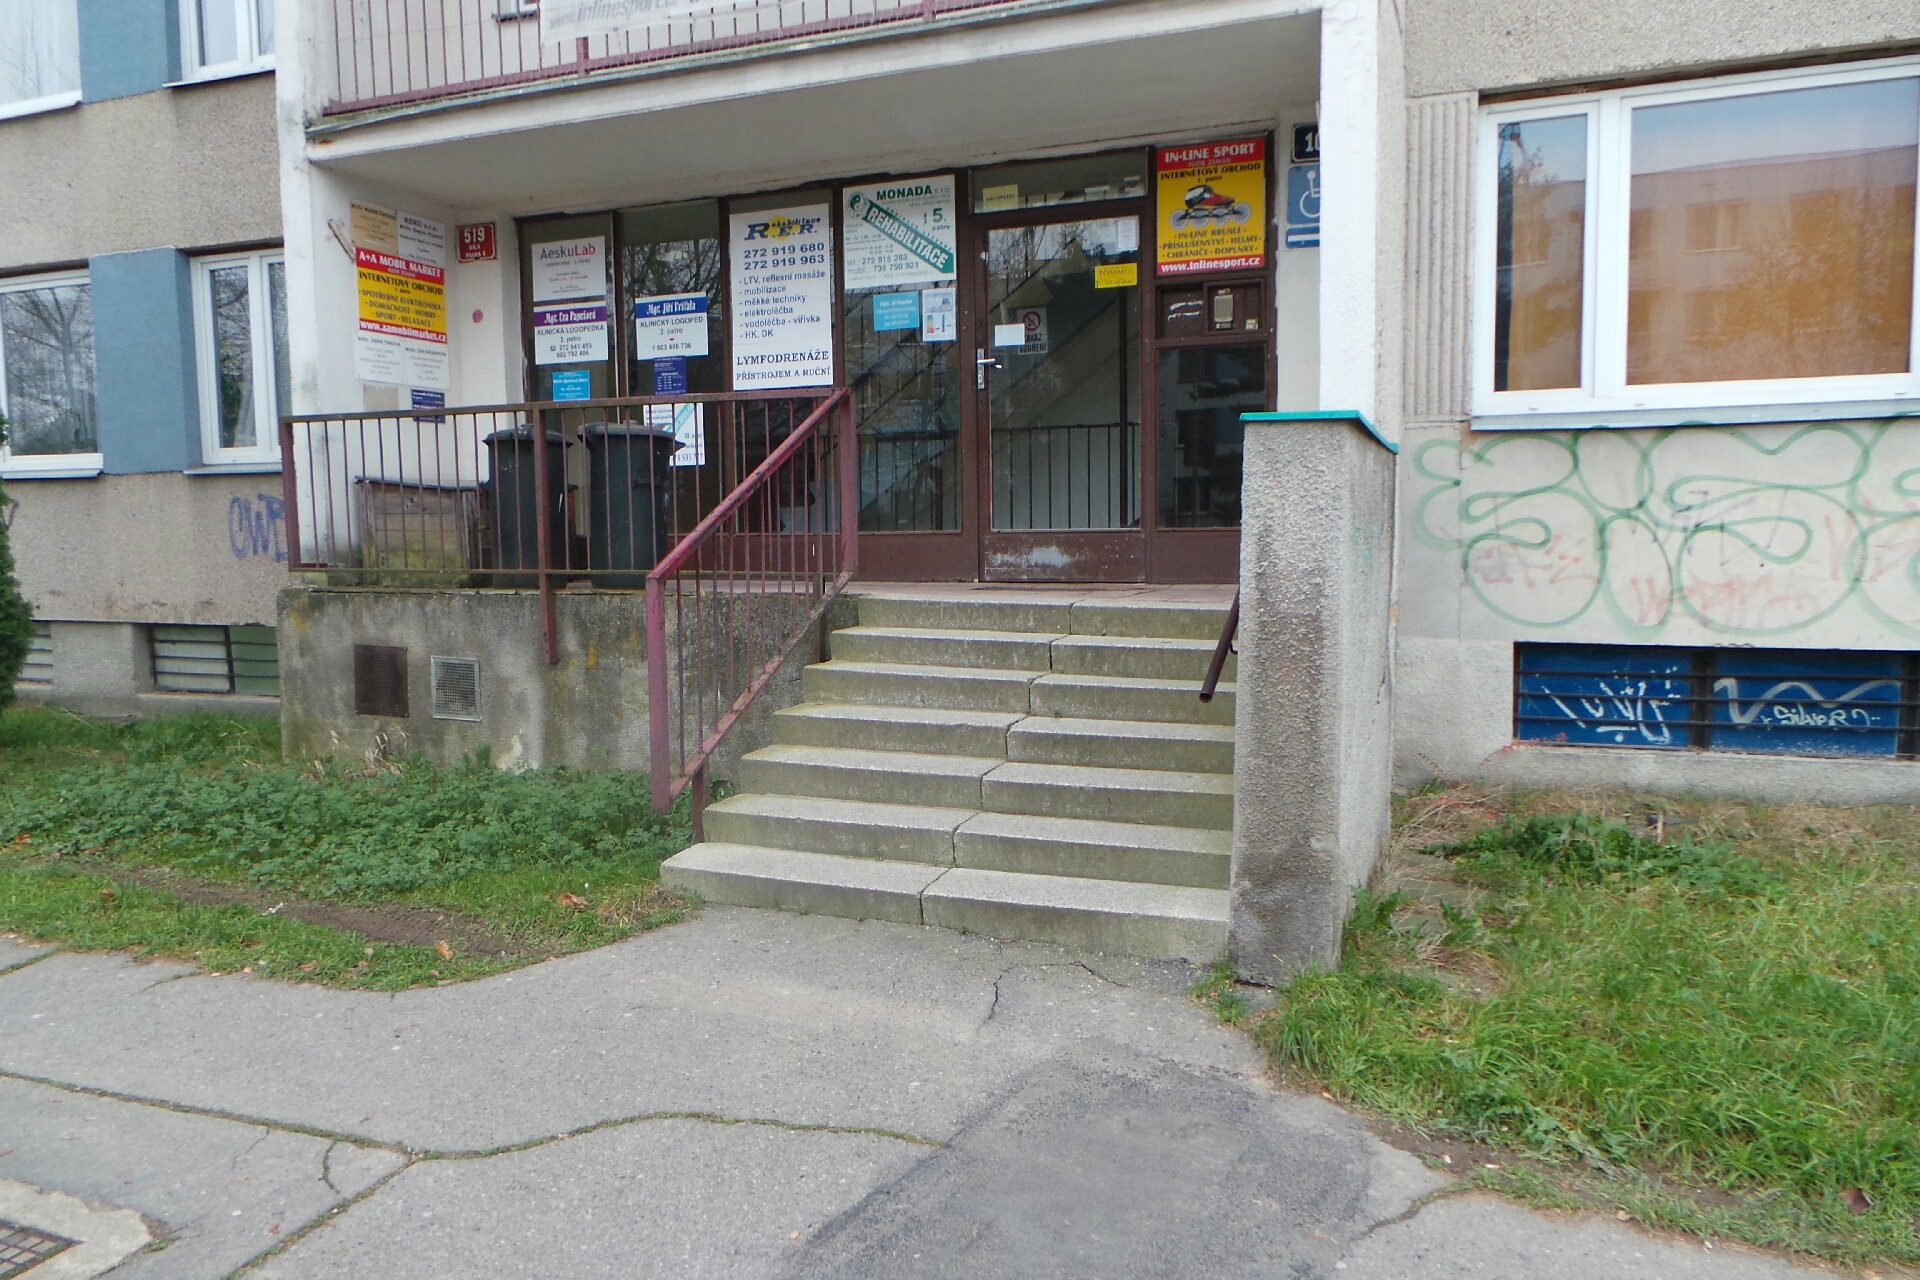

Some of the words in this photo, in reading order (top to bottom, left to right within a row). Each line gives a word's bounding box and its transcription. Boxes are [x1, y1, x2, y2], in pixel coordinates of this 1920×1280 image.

[1165, 148, 1210, 163] IN-LINE
[1213, 142, 1255, 157] SPORT
[1221, 162, 1261, 173] OBCHOD
[876, 185, 932, 201] MONADA
[464, 226, 485, 243] 519
[867, 207, 948, 269] REHABILITACE
[540, 242, 596, 260] AeskuLab
[744, 248, 768, 259] 272
[772, 245, 796, 256] 919
[800, 242, 824, 253] 680
[359, 250, 378, 264] A+A
[379, 254, 408, 270] MOBIL
[409, 262, 441, 278] MARKET
[744, 260, 768, 271] 272
[772, 257, 796, 268] 919
[800, 254, 825, 265] 963
[1161, 257, 1260, 272] www.inlinesport.cz
[762, 272, 792, 283] reflexní
[794, 270, 826, 280] masáže
[411, 282, 443, 295] OBCHOD
[744, 285, 787, 296] mobilizace
[744, 297, 770, 306] měkké
[772, 294, 807, 304] techniky
[744, 307, 793, 318] elektroléčba
[671, 316, 704, 325] LOGOPED
[744, 317, 786, 328] vodoléčba
[565, 324, 605, 334] LOGOPEDKA
[667, 327, 683, 335] patro
[761, 329, 774, 337] DK
[566, 336, 582, 344] patro
[736, 349, 829, 366] LYMFODRENÁŽE
[736, 370, 791, 380] PŘÍSTROJEM
[802, 366, 830, 377] RUČNÍ
